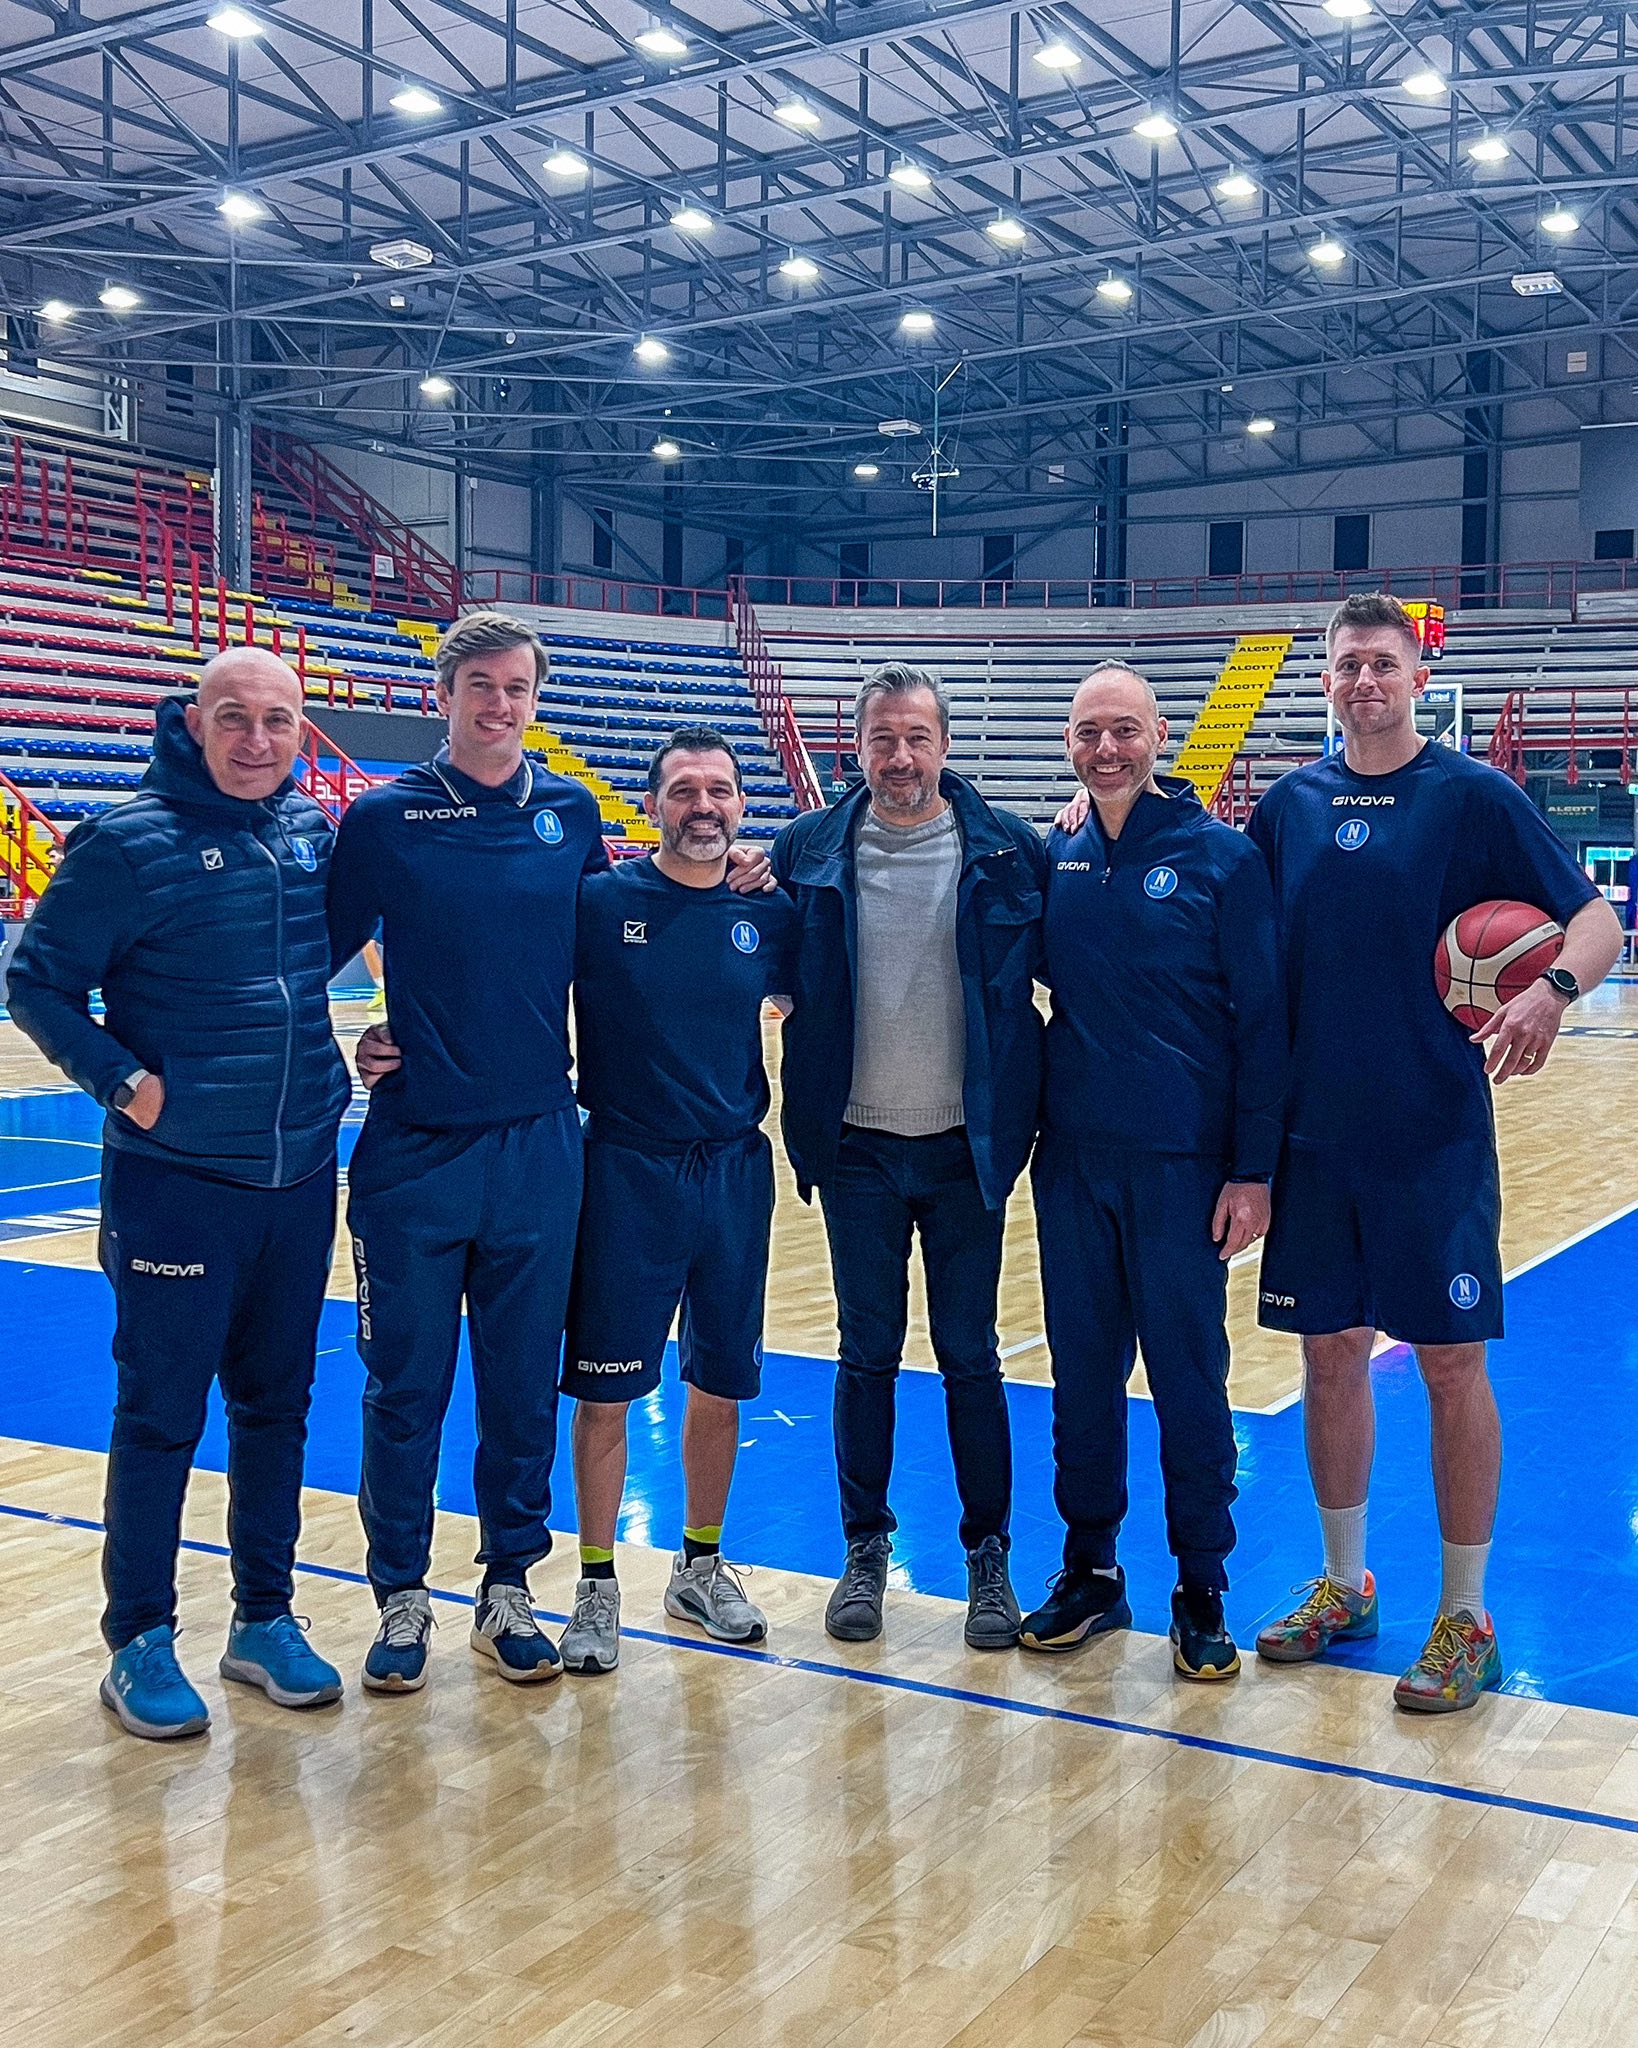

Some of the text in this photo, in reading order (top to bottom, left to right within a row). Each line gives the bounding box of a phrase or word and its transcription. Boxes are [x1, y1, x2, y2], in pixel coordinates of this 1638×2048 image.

[413, 633, 440, 643] ALCOT
[1218, 683, 1265, 691] ALCOTT
[1208, 702, 1255, 710] ALCOTT
[538, 747, 569, 755] ALCOTT
[563, 770, 595, 779] ALCOTT
[596, 794, 620, 802] LCOTT
[1332, 795, 1395, 806] GIVOVA
[404, 806, 477, 821] GIVOVA
[1547, 805, 1596, 813] ALCOTT
[543, 814, 555, 832] N
[615, 818, 647, 826] ALCOTT
[1347, 823, 1361, 839] N
[1154, 870, 1169, 888] N
[740, 925, 750, 944] N
[130, 1258, 205, 1277] GIVOVA
[1459, 1278, 1470, 1297] N
[577, 1360, 642, 1374] GIVOVA
